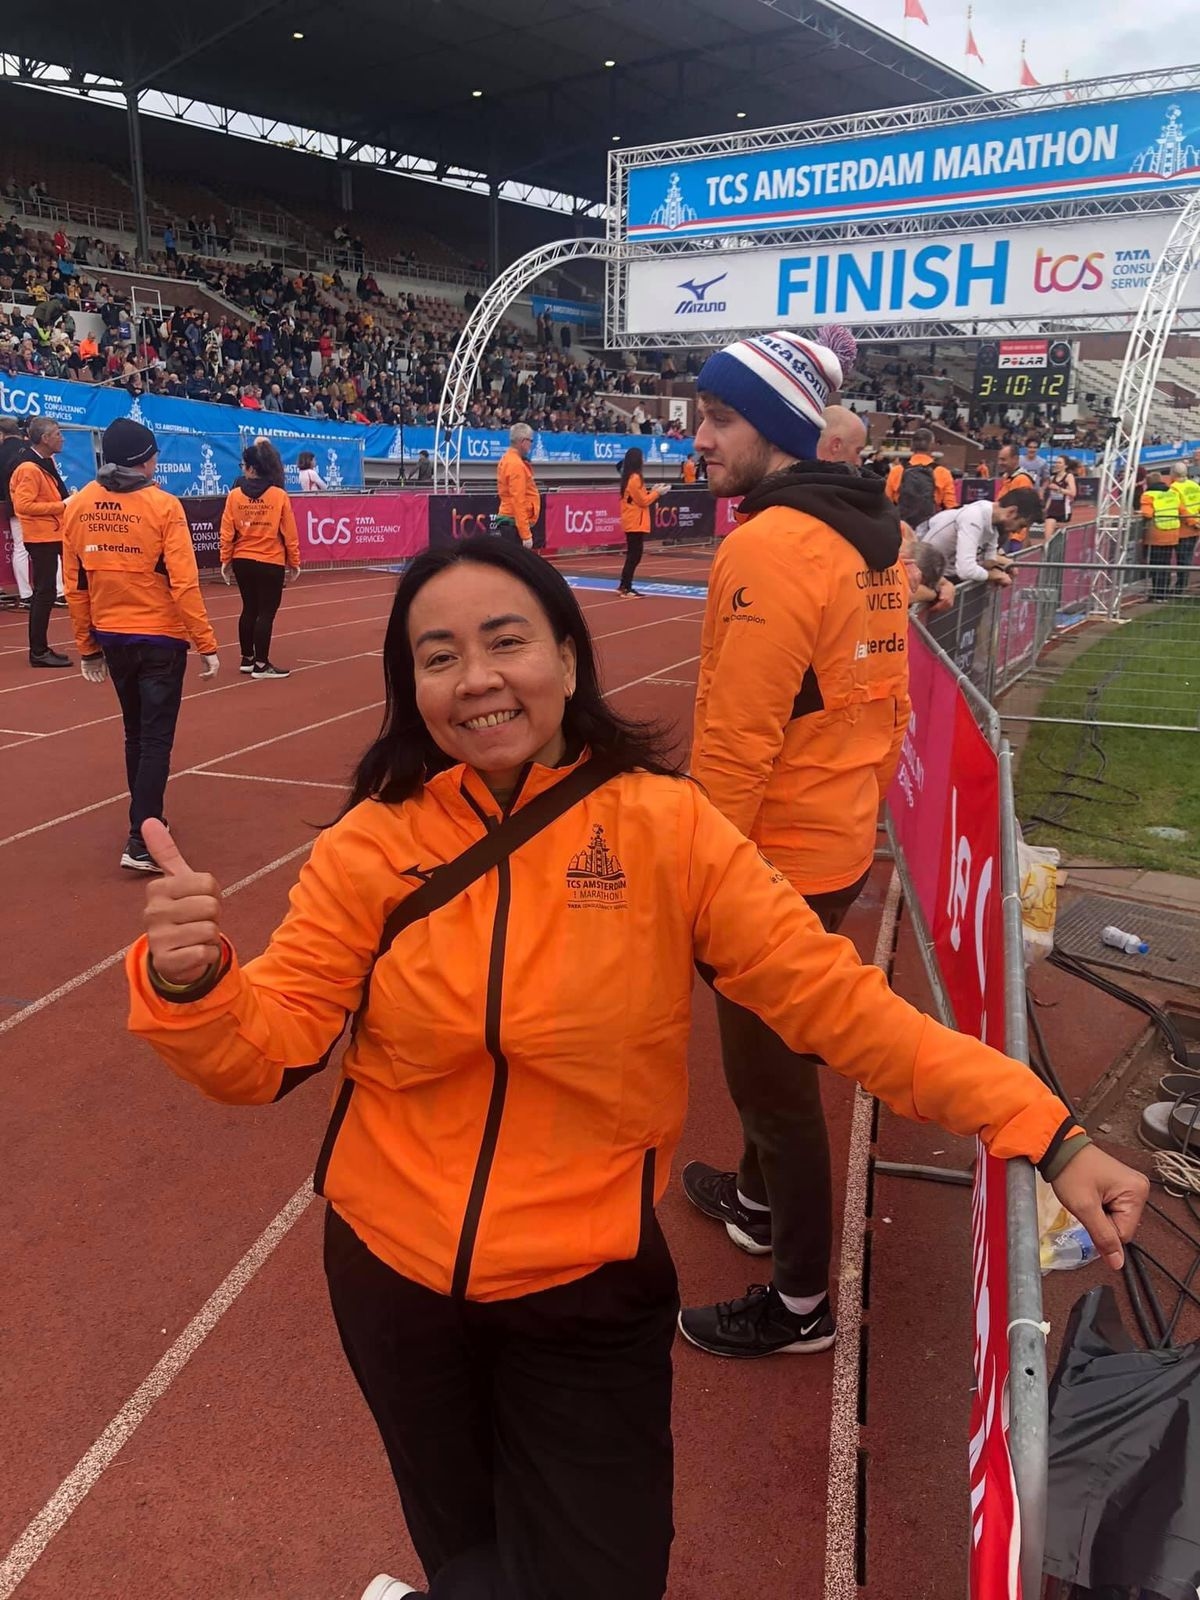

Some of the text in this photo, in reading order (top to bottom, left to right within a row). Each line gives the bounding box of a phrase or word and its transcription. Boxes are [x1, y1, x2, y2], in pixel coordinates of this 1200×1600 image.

[706, 124, 1119, 206] TCS AMSTERDAM MARATHON
[1115, 249, 1151, 262] TATA
[1034, 247, 1105, 293] tcs
[777, 240, 1011, 316] FINISH
[674, 300, 727, 315] MIZUNO
[1001, 356, 1044, 366] POLAR
[0, 381, 42, 416] tcs
[44, 394, 62, 403] TATA
[44, 403, 87, 414] CONSULTANCY
[44, 411, 73, 421] SERVICES
[467, 435, 489, 457] tcs
[594, 439, 613, 458] tcs
[154, 463, 192, 473] STERDAM
[94, 502, 122, 511] TATA
[79, 512, 142, 525] CONSULTANCY
[565, 505, 593, 533] tcs
[655, 503, 678, 527] tcs
[191, 522, 213, 531] TATA
[355, 517, 375, 525] TATA
[452, 508, 487, 539] tcs
[88, 523, 129, 533] SERVICES
[307, 510, 352, 545] tcs
[355, 525, 401, 534] CONSULTANCY
[192, 531, 221, 542] CONSUL
[355, 534, 385, 543] SERVICES
[193, 542, 221, 552] SERVICE
[867, 592, 903, 611] VICES
[566, 879, 581, 889] TCS
[580, 890, 619, 900] MARATHON
